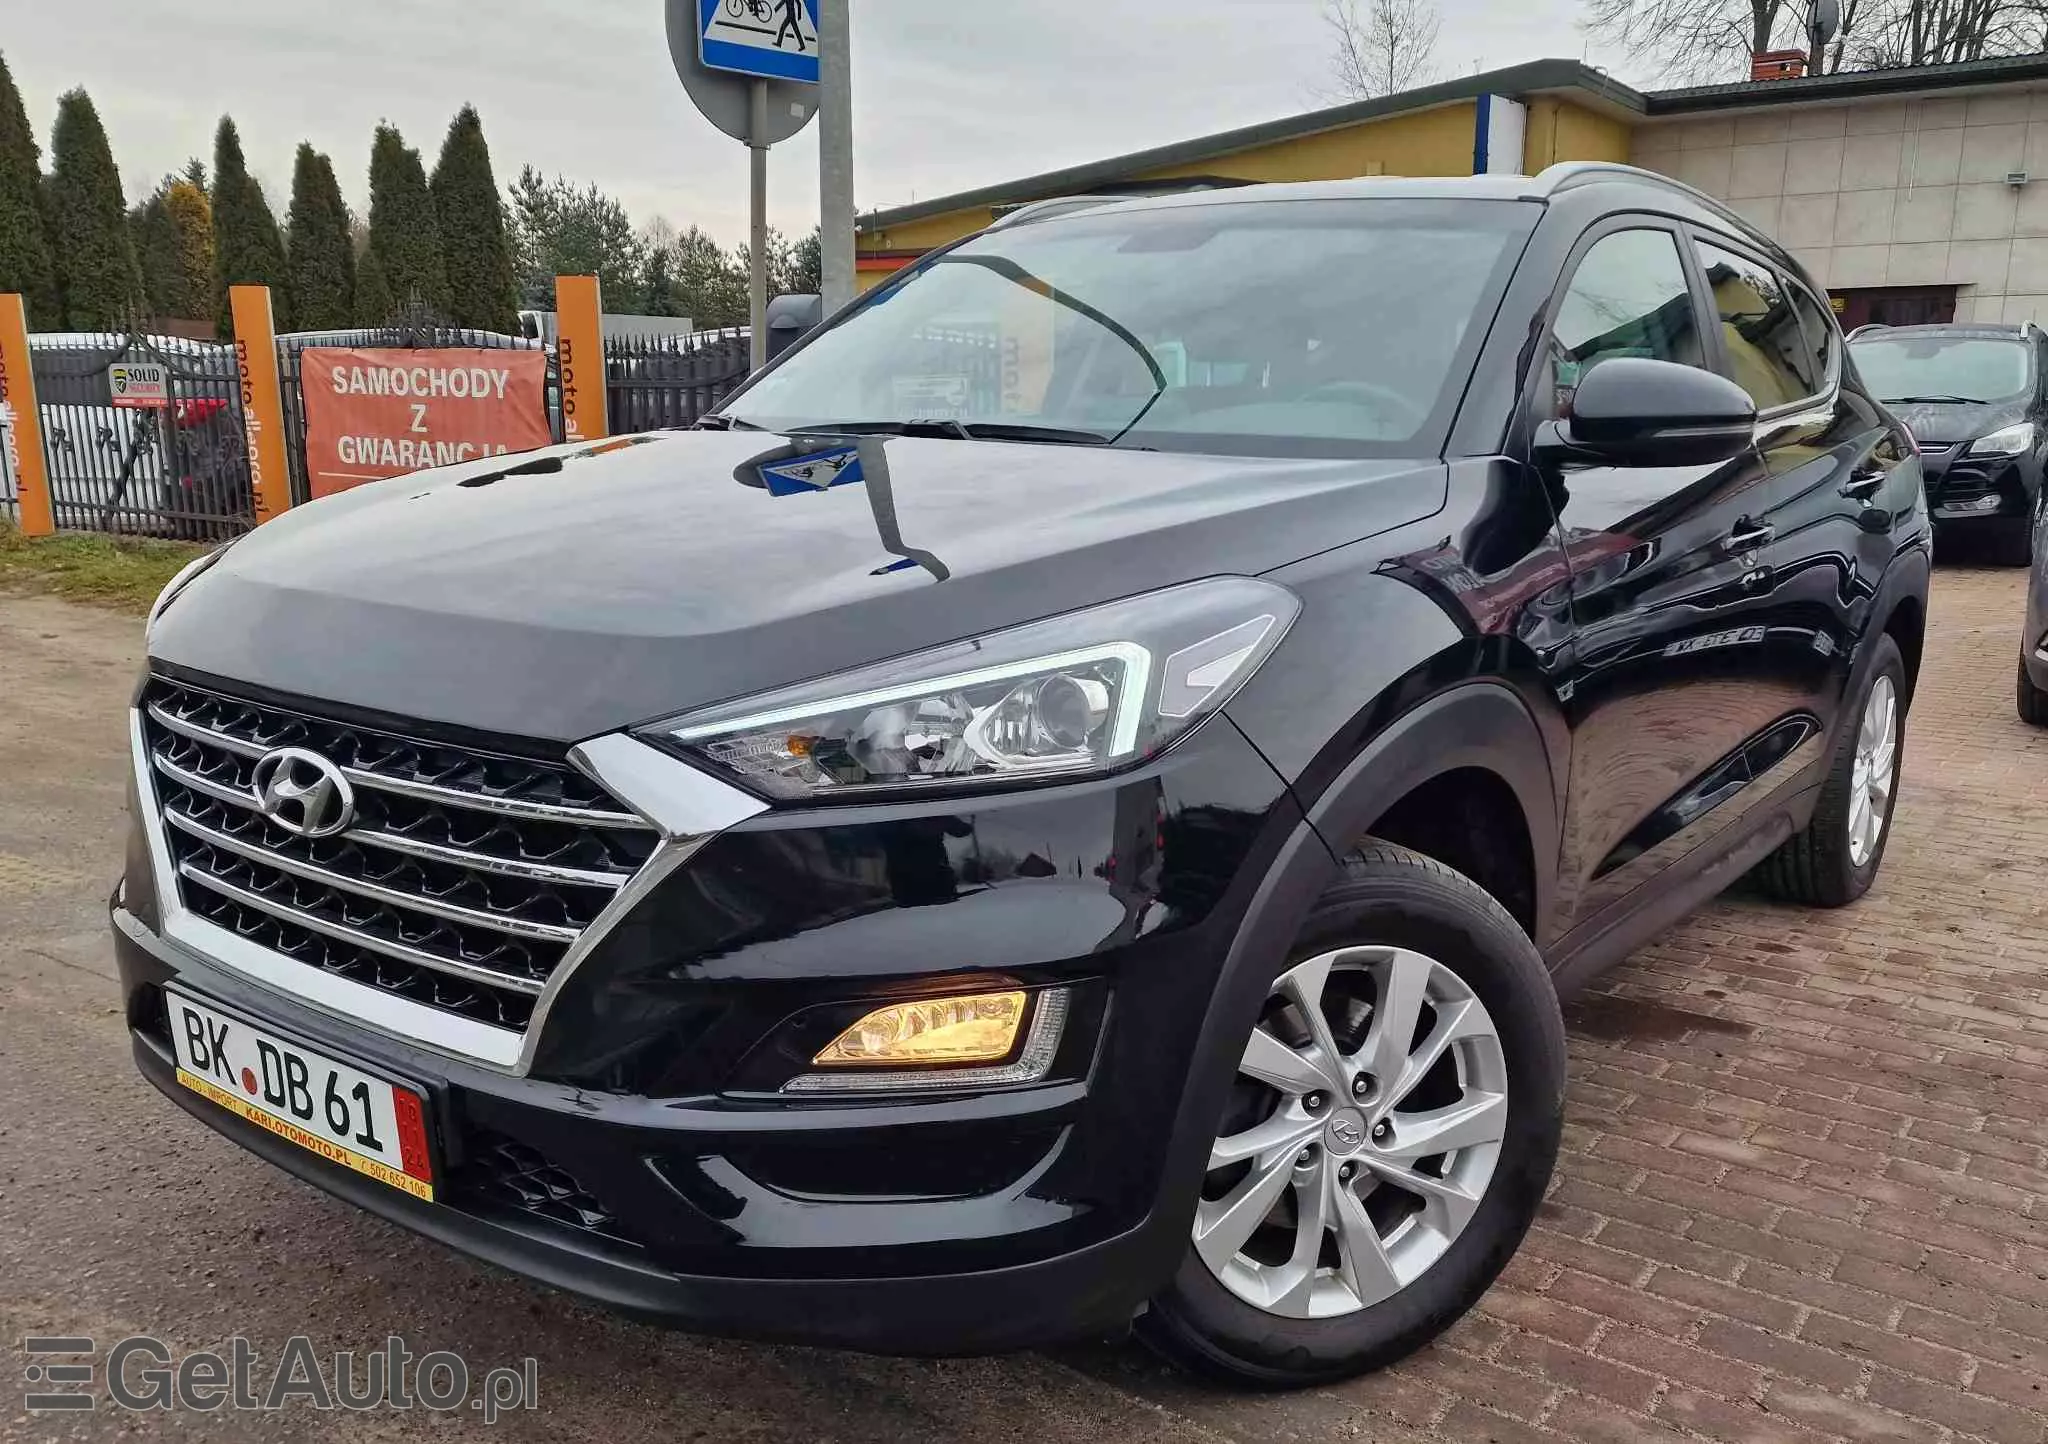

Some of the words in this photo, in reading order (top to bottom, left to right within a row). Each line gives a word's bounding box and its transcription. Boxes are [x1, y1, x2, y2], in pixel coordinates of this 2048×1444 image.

[127, 368, 160, 382] SOLID
[332, 366, 510, 399] SAMOCHODY
[410, 403, 428, 433] Z
[182, 1006, 237, 1086] BK
[256, 1038, 314, 1121] DB
[324, 1070, 384, 1153] 61
[370, 1162, 387, 1180] 502
[390, 1171, 407, 1189] 652
[409, 1181, 426, 1197] 106
